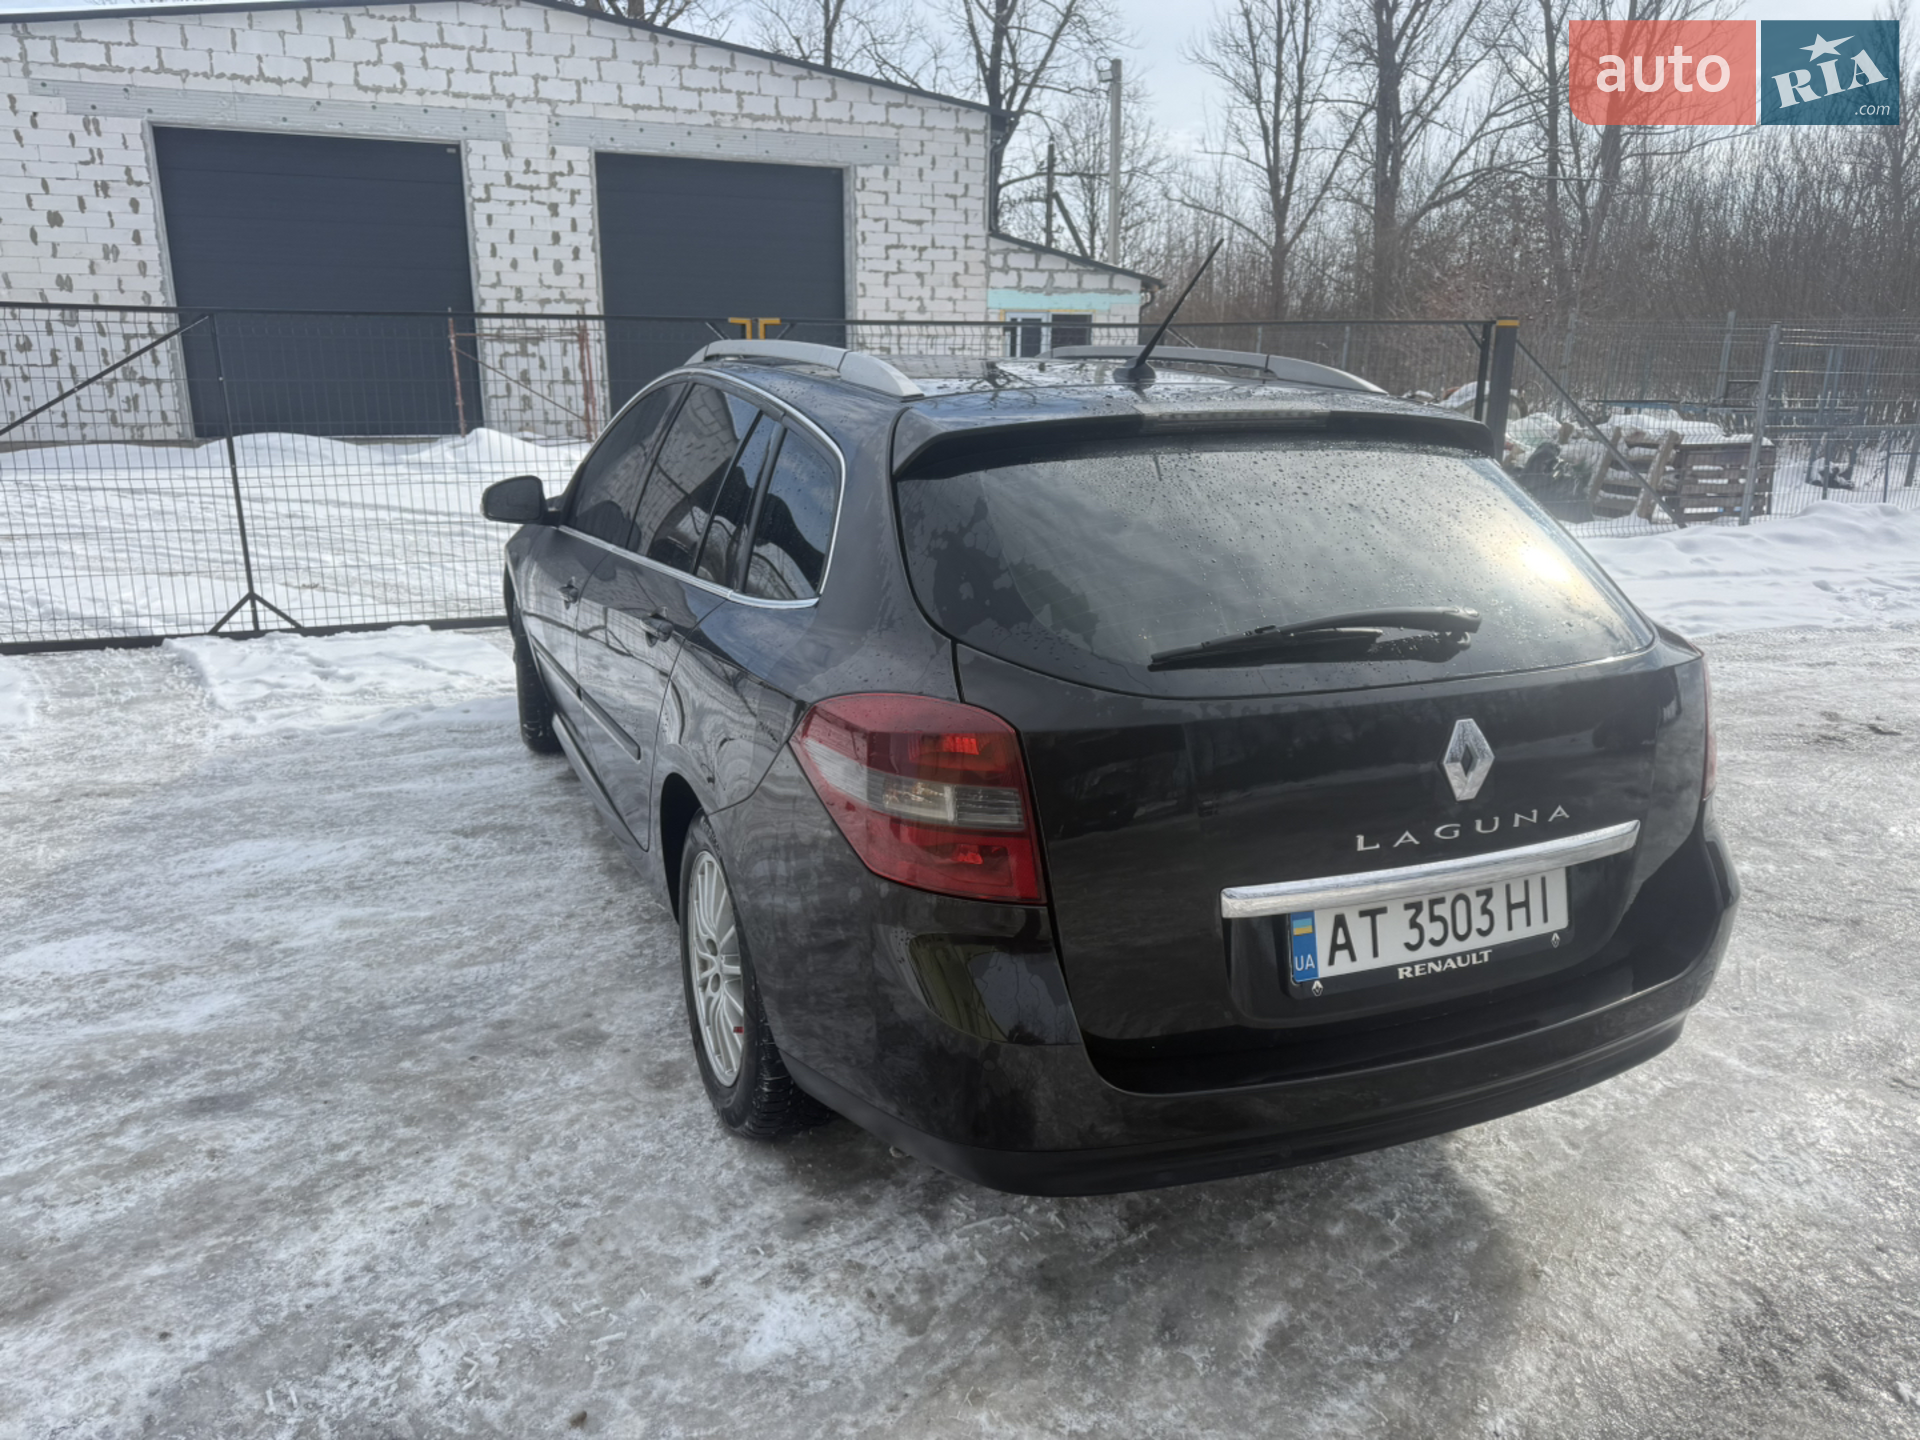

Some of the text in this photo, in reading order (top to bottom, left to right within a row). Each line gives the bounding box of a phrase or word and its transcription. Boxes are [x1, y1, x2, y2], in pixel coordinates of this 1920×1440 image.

[1356, 805, 1570, 851] LAGUNA
[1327, 875, 1549, 966] AT 3503 HI
[1294, 954, 1316, 972] UA
[1397, 949, 1493, 979] RENAULT
